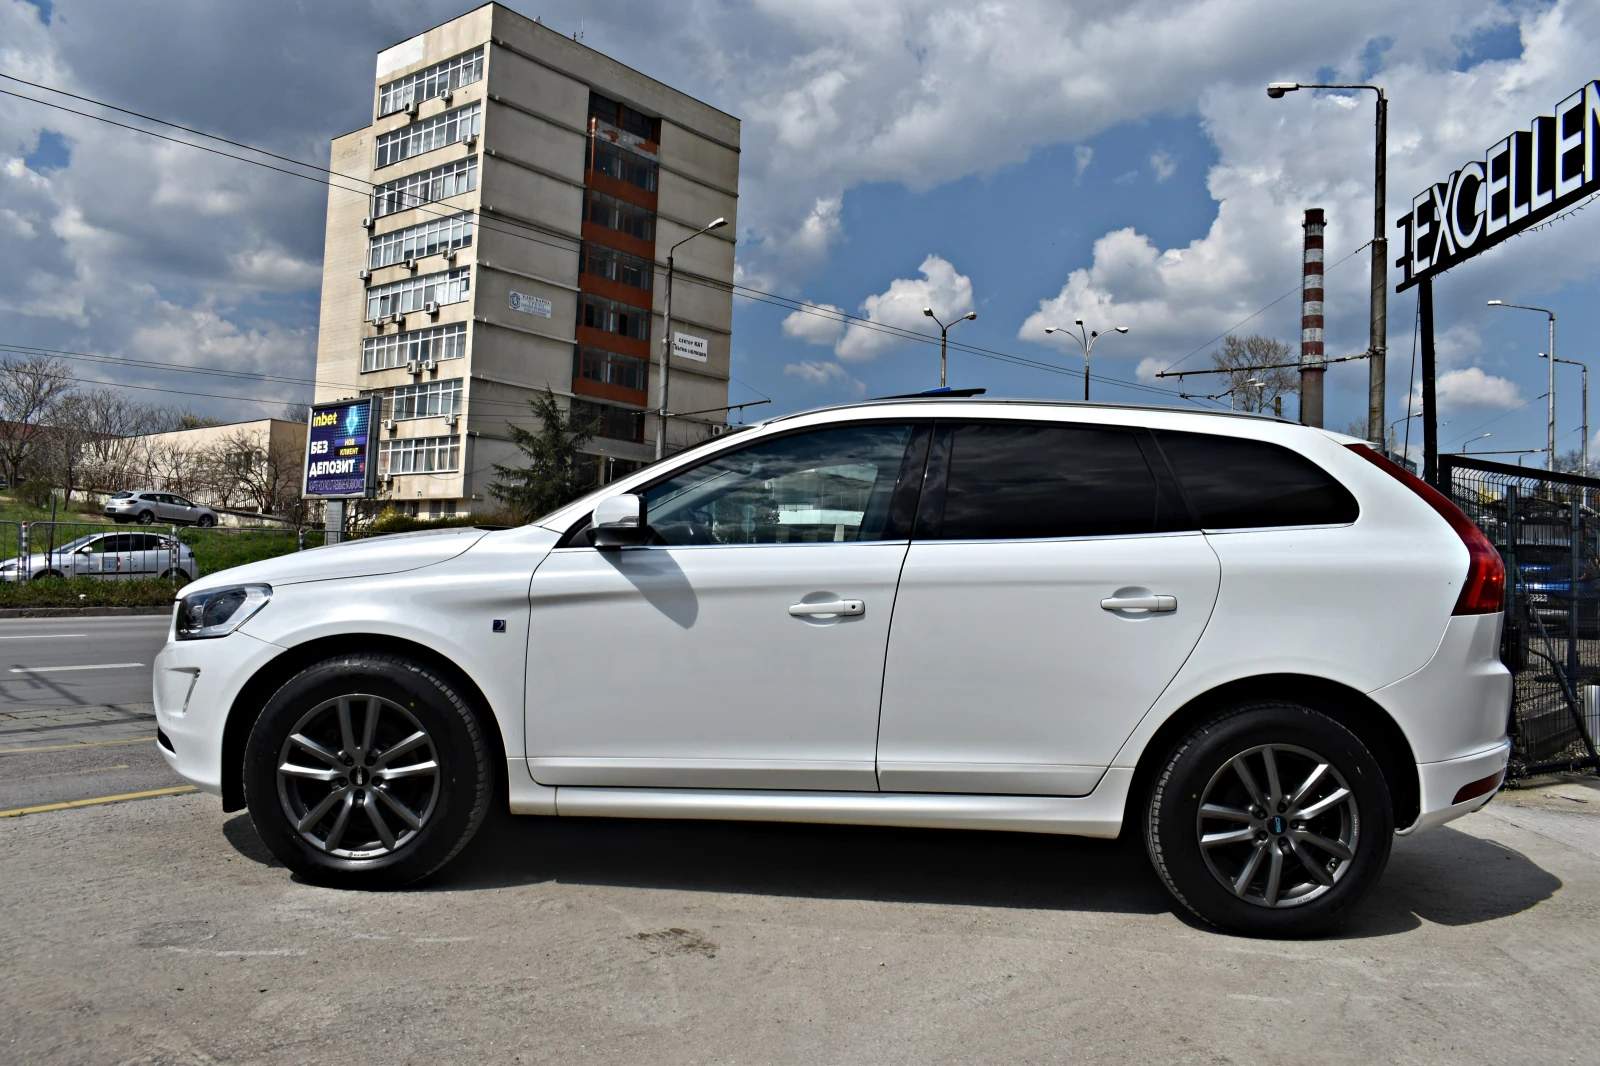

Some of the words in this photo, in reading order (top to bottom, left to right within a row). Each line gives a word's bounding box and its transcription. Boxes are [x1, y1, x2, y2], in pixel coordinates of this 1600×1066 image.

[313, 411, 338, 427] inbet
[310, 440, 329, 455] БЕЗ
[344, 438, 355, 446] НОВ
[339, 447, 359, 456] КЛИЕНТ
[309, 459, 356, 478] ДЕПОЗИТ
